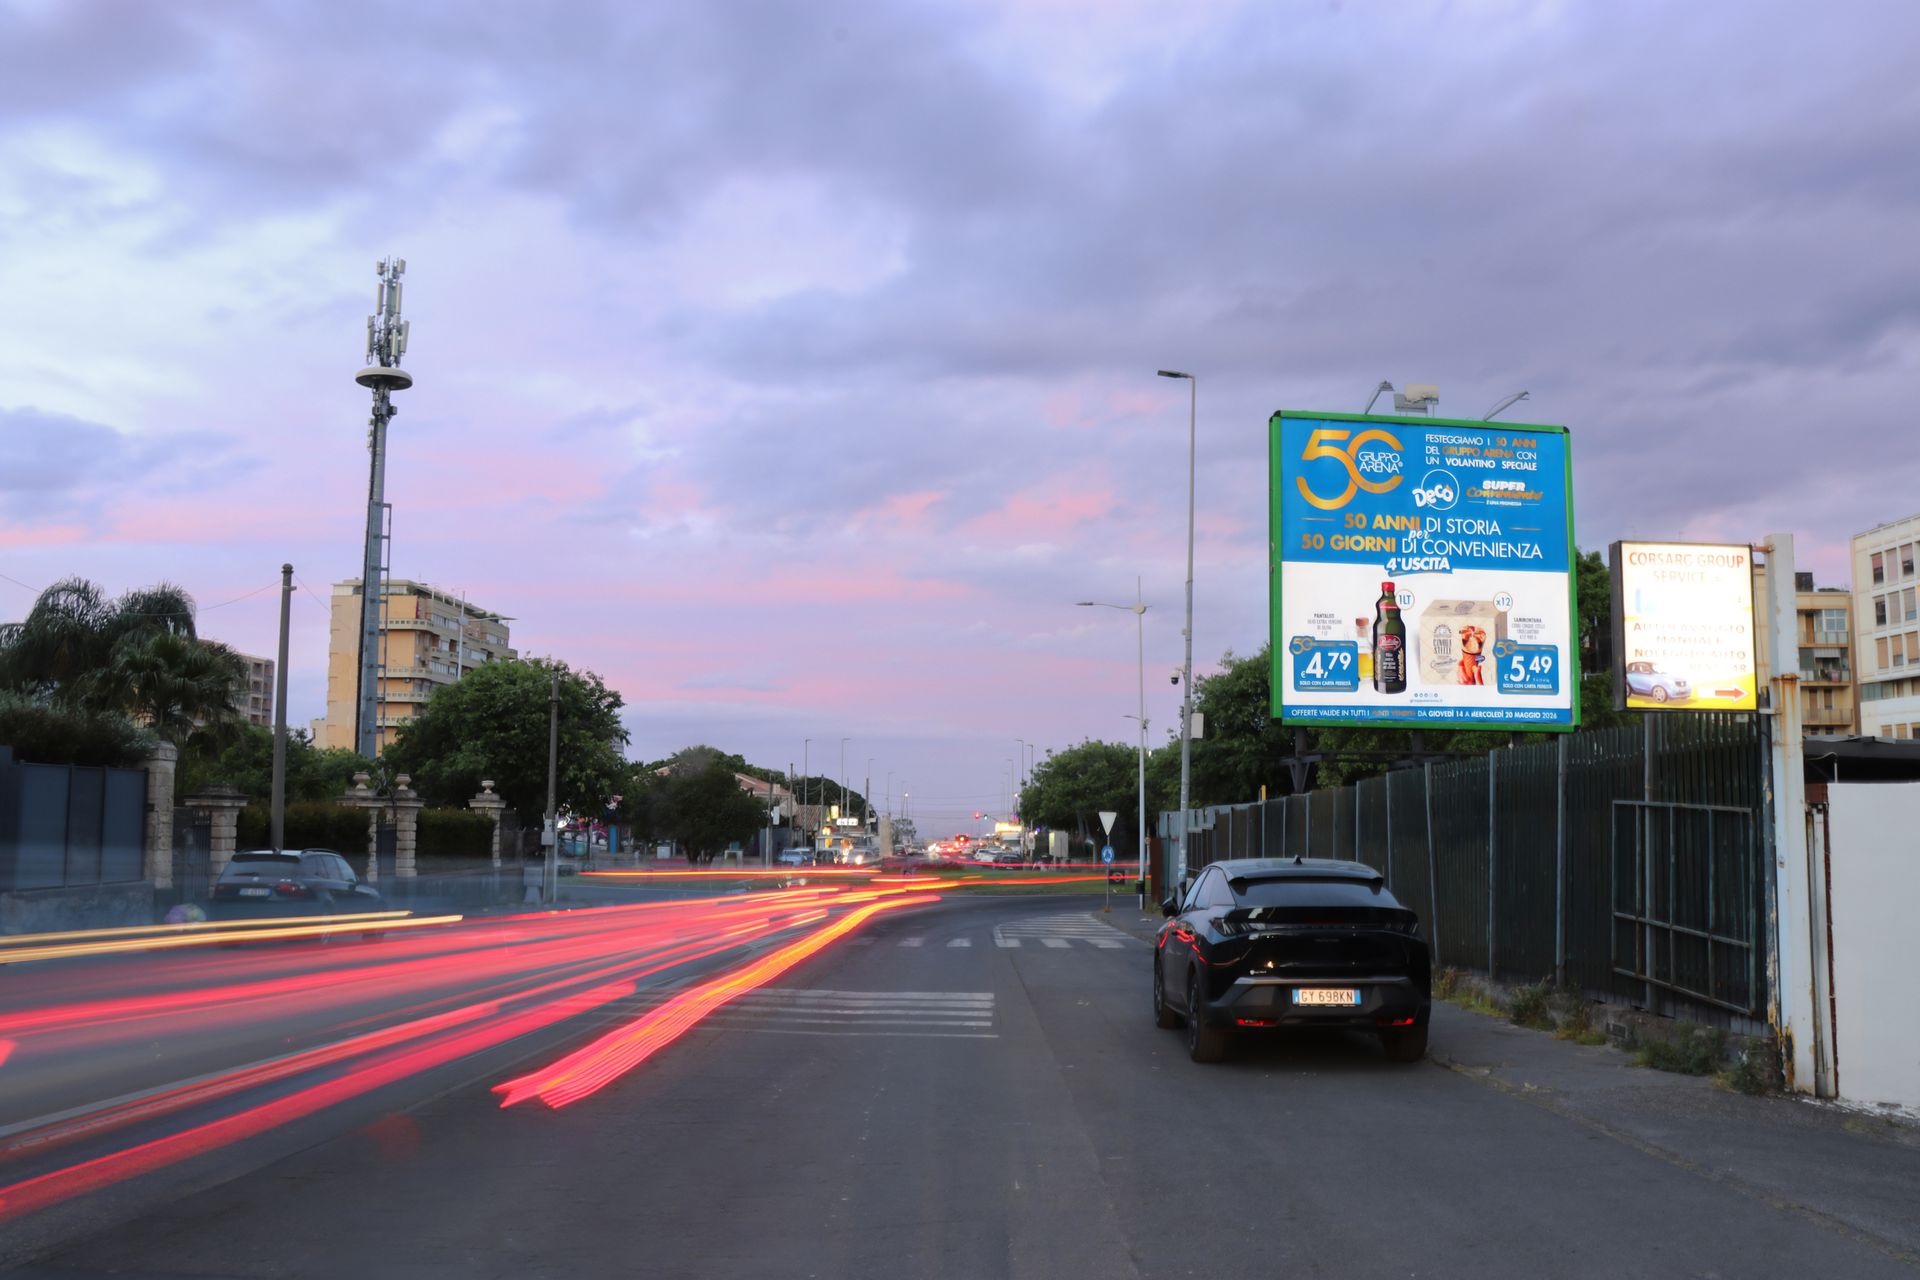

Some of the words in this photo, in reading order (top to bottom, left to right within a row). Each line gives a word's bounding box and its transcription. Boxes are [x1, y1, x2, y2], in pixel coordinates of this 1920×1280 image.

[1425, 434, 1483, 446] FESTEGGIAMO
[1495, 437, 1507, 446] 50
[1512, 438, 1537, 448] ANNI
[1358, 451, 1400, 463] GRUPPO
[1425, 446, 1440, 455] DEL
[1442, 446, 1480, 456] GRUPPO
[1483, 448, 1515, 459] ARENA
[1516, 451, 1537, 460] CON
[1425, 457, 1440, 465] UN
[1445, 457, 1496, 469] VOLANTINO
[1501, 461, 1537, 471] SPECIALE
[1482, 480, 1526, 492] SUPER
[1344, 513, 1367, 529] 50
[1372, 514, 1420, 531] ANNI
[1426, 517, 1441, 533] DI
[1446, 518, 1502, 536] STORIA
[1408, 529, 1430, 543] per
[1301, 533, 1325, 549] 50
[1330, 534, 1396, 553] GIORNI
[1402, 538, 1417, 554] DI
[1421, 539, 1543, 559] CONVENIENZA
[1697, 554, 1744, 568] GROUP
[1514, 711, 1541, 719] MAGGIO
[1319, 991, 1353, 1003] 698KN
